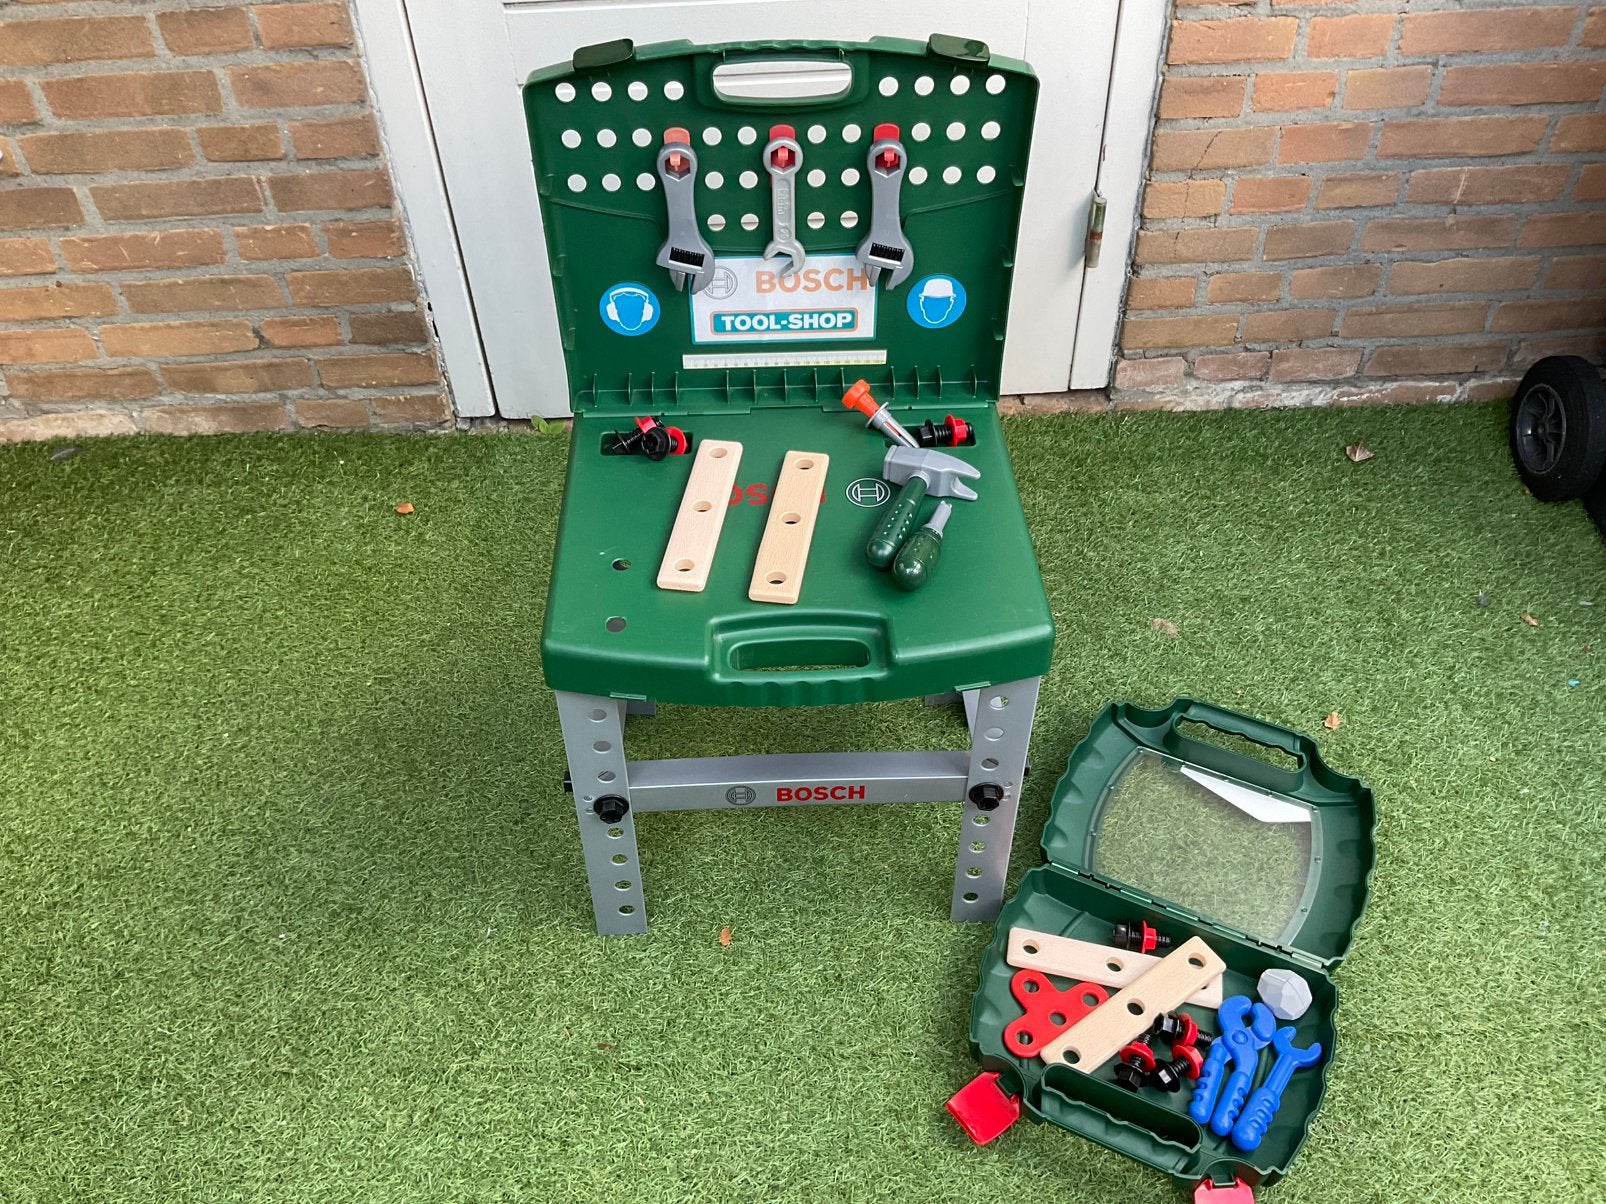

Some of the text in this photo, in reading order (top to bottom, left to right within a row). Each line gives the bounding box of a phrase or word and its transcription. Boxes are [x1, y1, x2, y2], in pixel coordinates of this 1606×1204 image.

[755, 267, 868, 294] BOSCH
[721, 312, 853, 331] TOOL-SHOP
[776, 785, 866, 802] BOSCH
